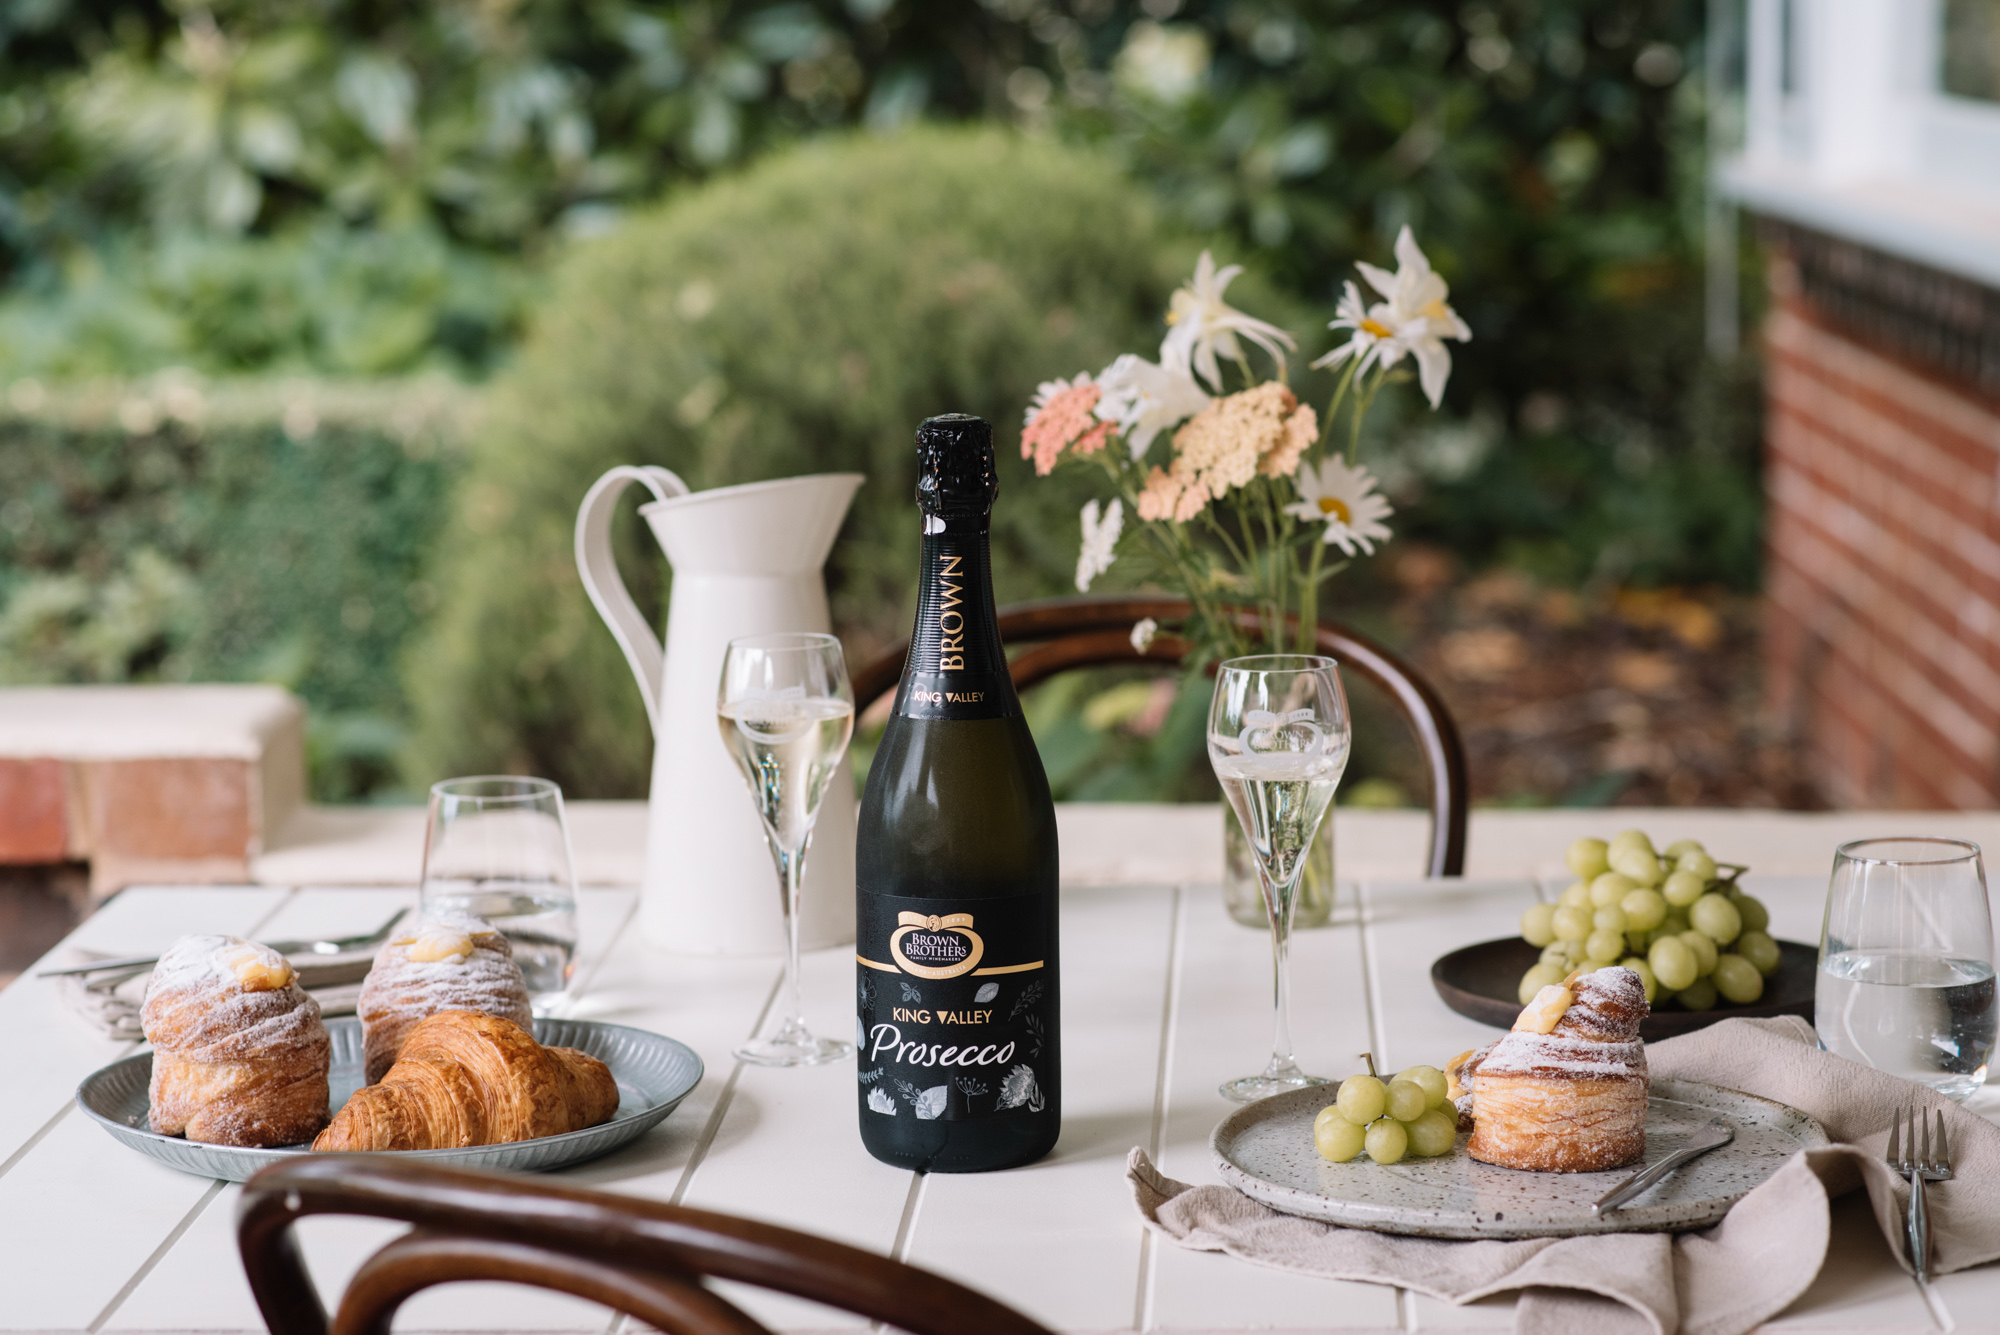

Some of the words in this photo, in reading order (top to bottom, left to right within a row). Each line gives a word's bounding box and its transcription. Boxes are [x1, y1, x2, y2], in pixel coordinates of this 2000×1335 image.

[939, 554, 965, 671] BROWN
[913, 690, 942, 703] KING
[945, 691, 985, 703] VALLEY
[1254, 738, 1312, 750] BROTHRS
[911, 932, 959, 946] BROWN
[905, 942, 967, 957] BROTHERS
[892, 1007, 931, 1024] KING
[936, 1010, 993, 1025] VALLEY
[870, 1023, 1016, 1067] Prosecco
